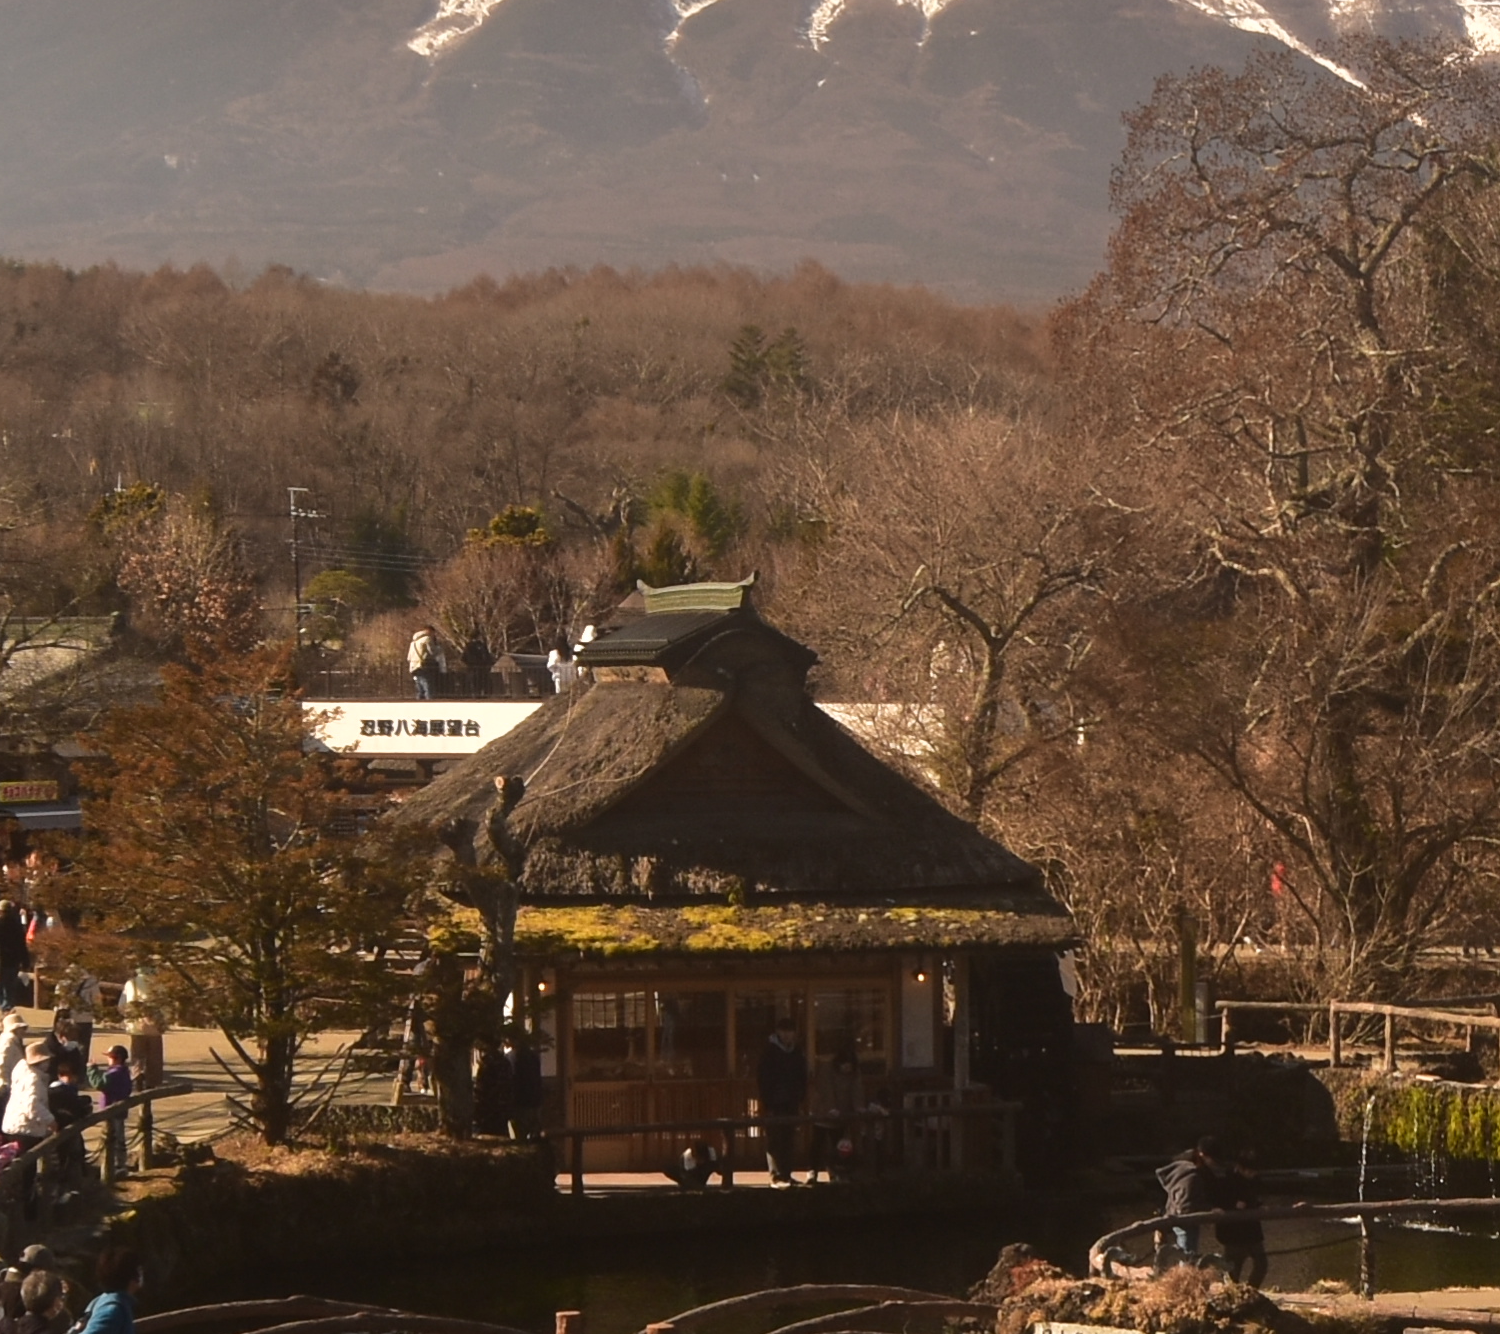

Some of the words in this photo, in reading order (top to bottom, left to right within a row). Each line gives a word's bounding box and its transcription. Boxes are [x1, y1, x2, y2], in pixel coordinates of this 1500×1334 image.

[359, 719, 481, 737] 忍野八海展望台
